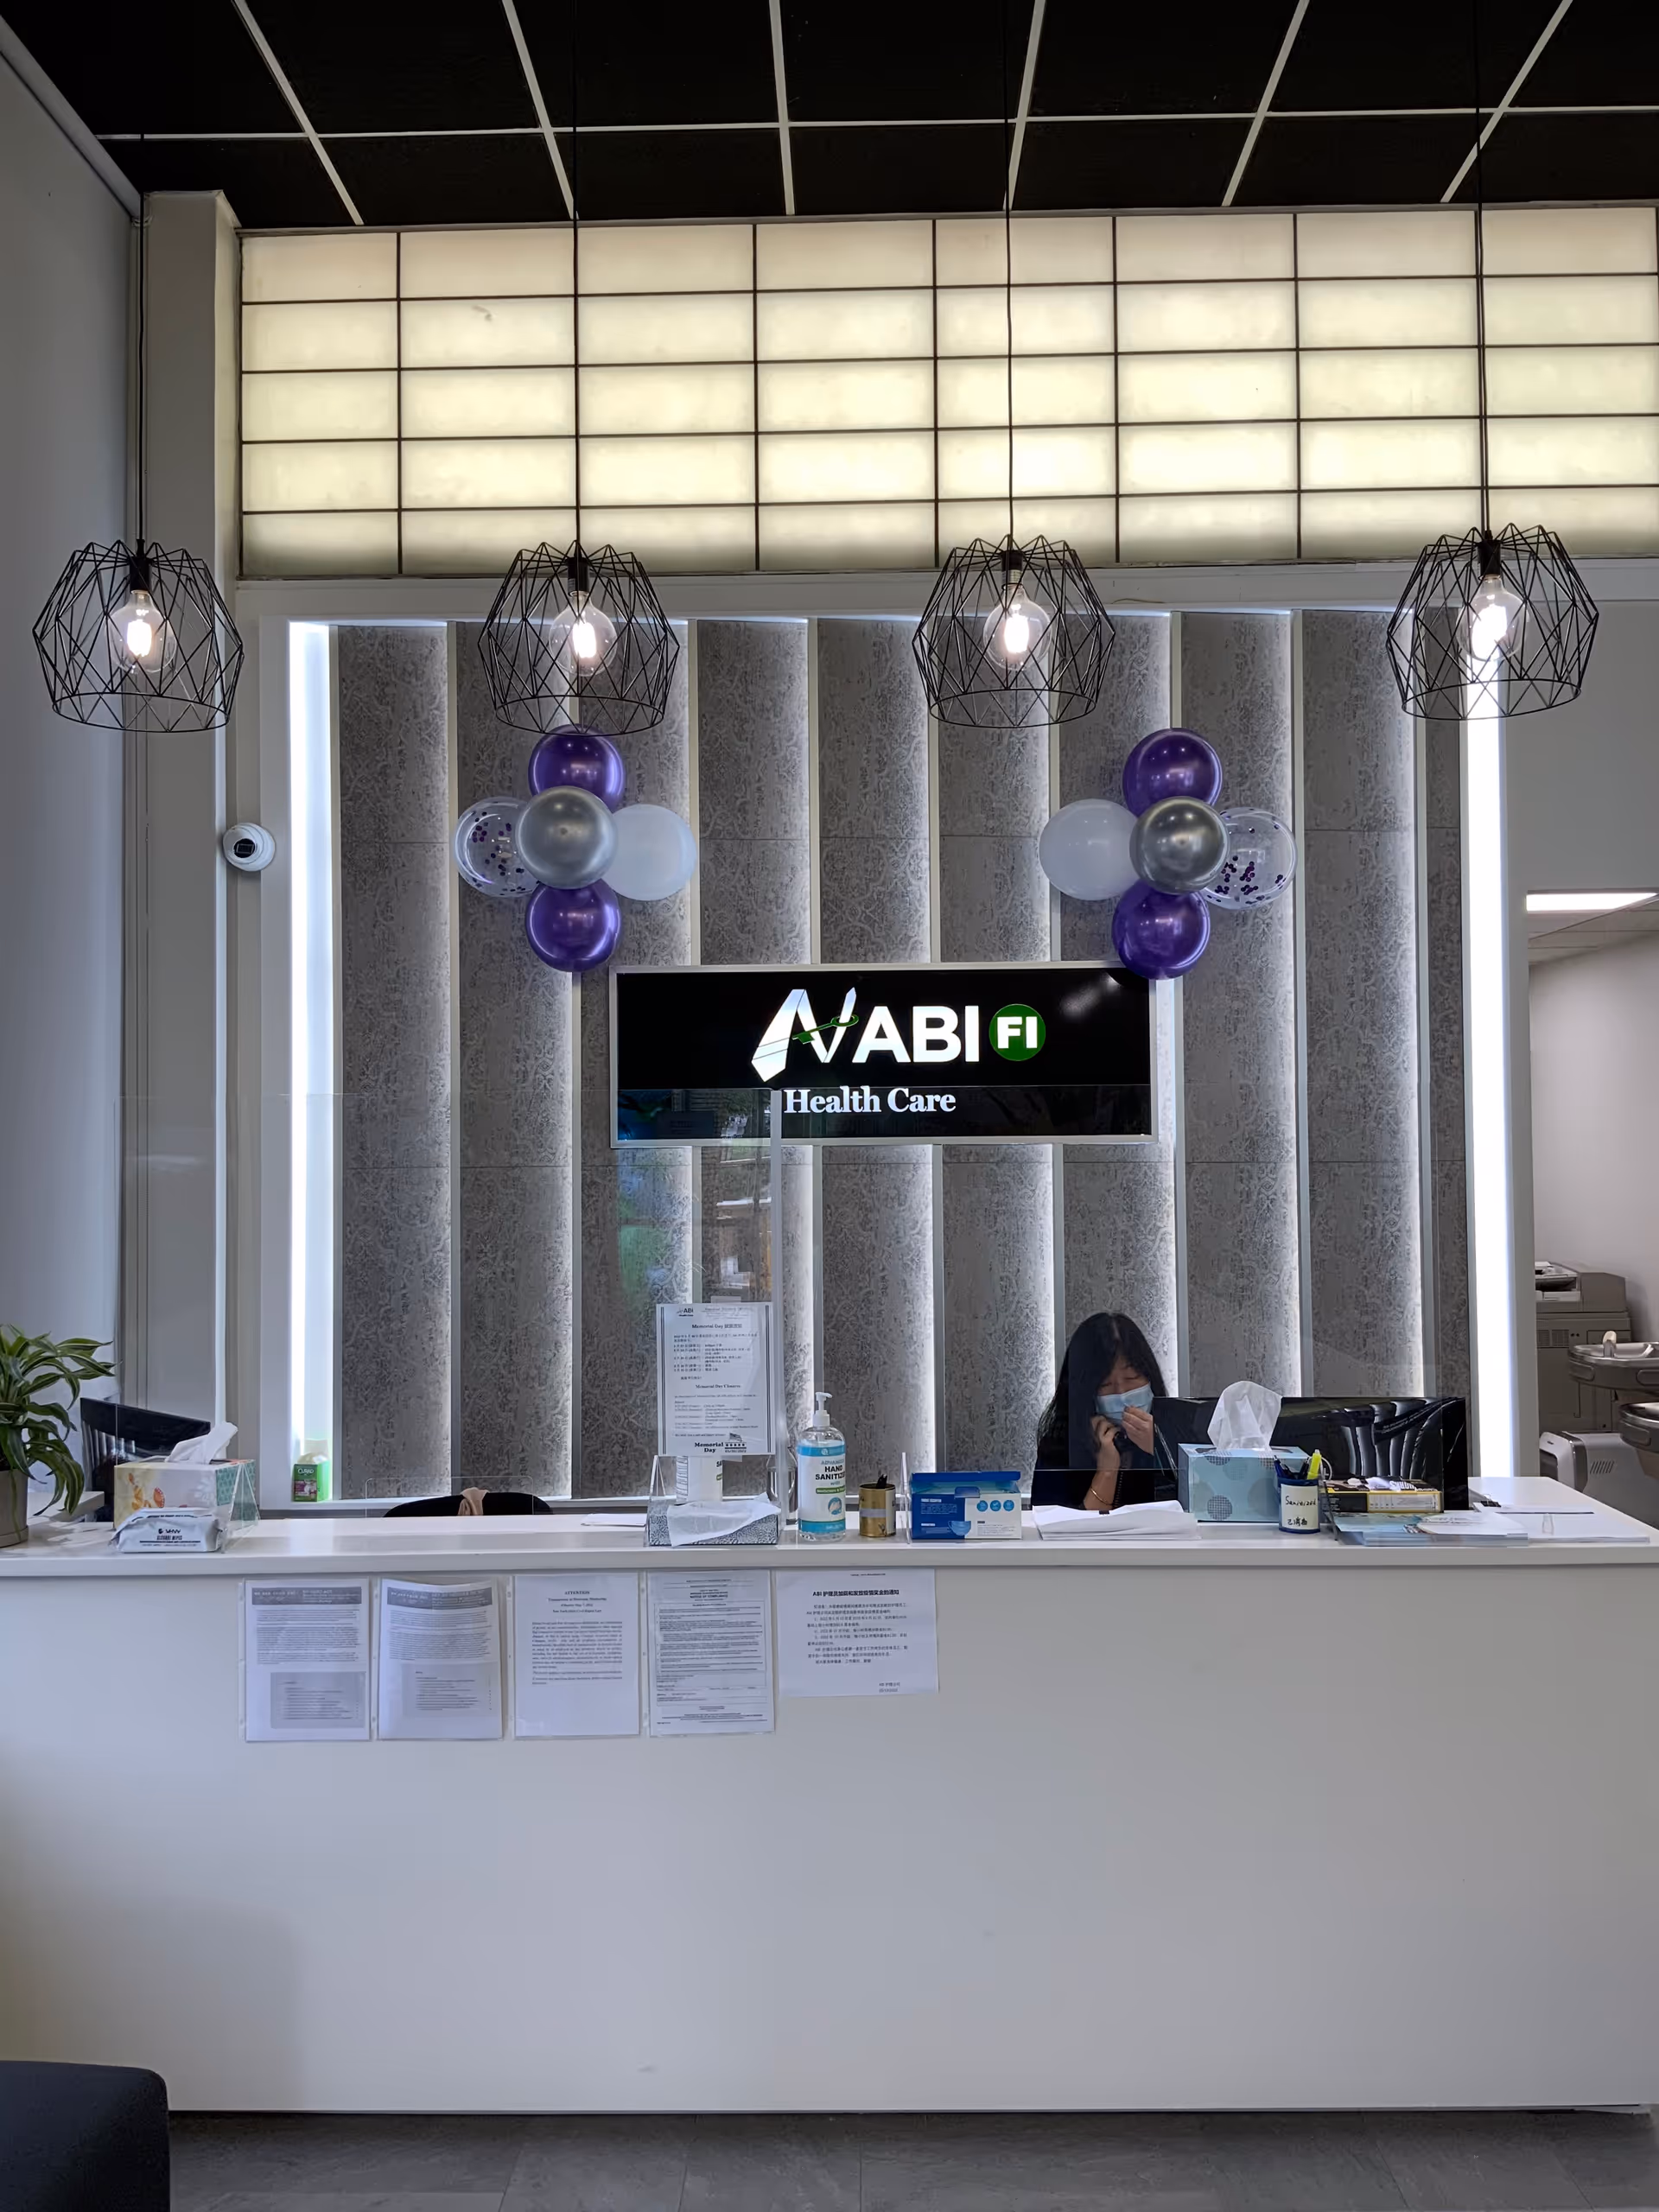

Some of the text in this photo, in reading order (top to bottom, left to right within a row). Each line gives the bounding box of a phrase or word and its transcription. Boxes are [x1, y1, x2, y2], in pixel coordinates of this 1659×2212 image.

[995, 1015, 1039, 1050] FI
[783, 1085, 957, 1114] Health Care
[824, 1465, 843, 1473] HAND
[1284, 1495, 1317, 1507] Sanitized
